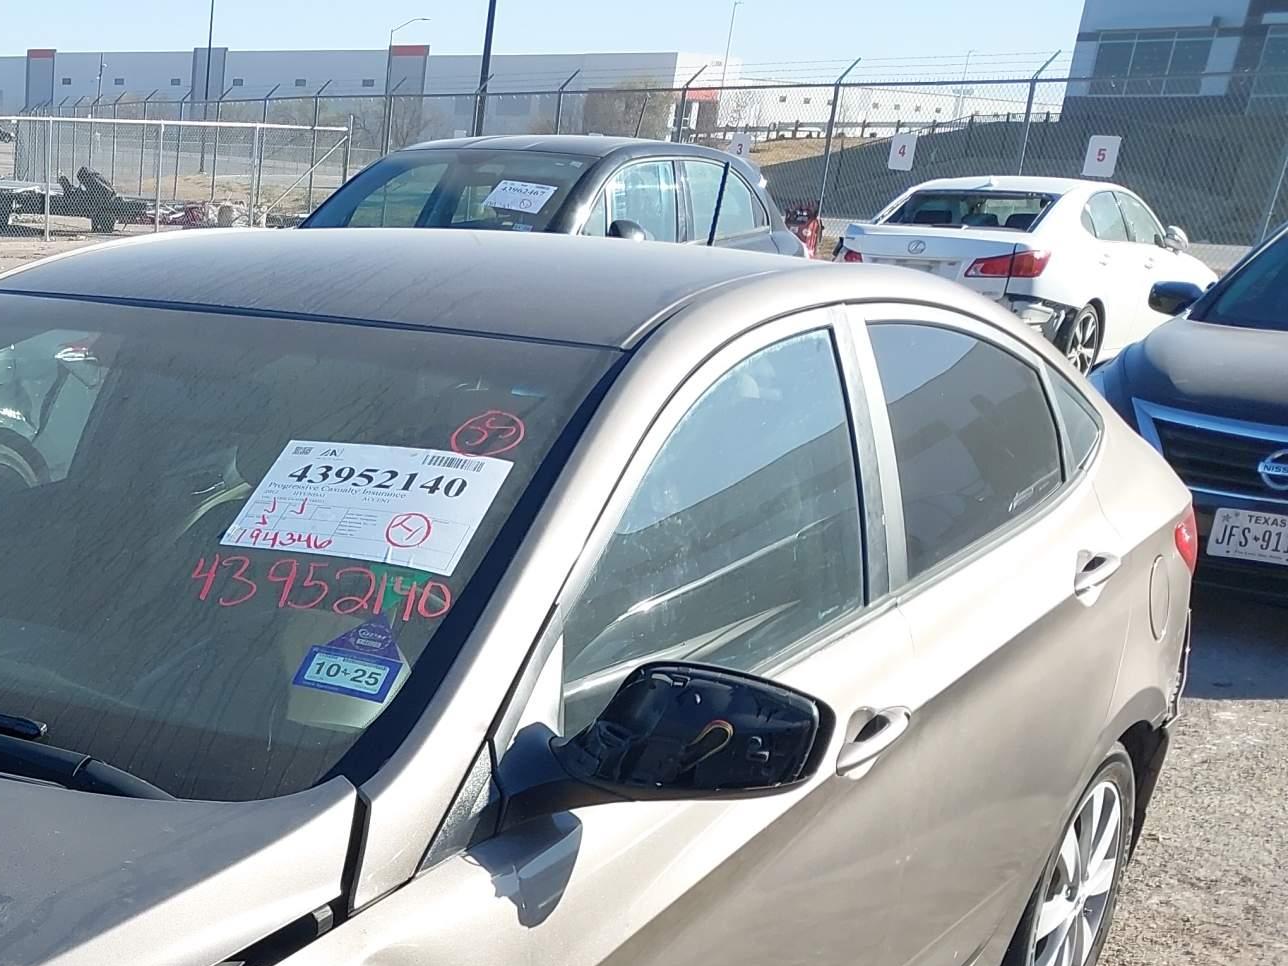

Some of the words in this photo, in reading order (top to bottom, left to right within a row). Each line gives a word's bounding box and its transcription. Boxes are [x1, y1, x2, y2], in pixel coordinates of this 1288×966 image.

[736, 143, 744, 155] 3
[898, 144, 907, 157] 4
[1096, 148, 1107, 162] 5
[288, 463, 468, 499] 43952140
[268, 482, 319, 493] Progressive
[320, 485, 360, 496] Casualty
[361, 488, 407, 499] Insurance
[1248, 514, 1287, 528] TEXAS
[192, 553, 452, 622] 43952140
